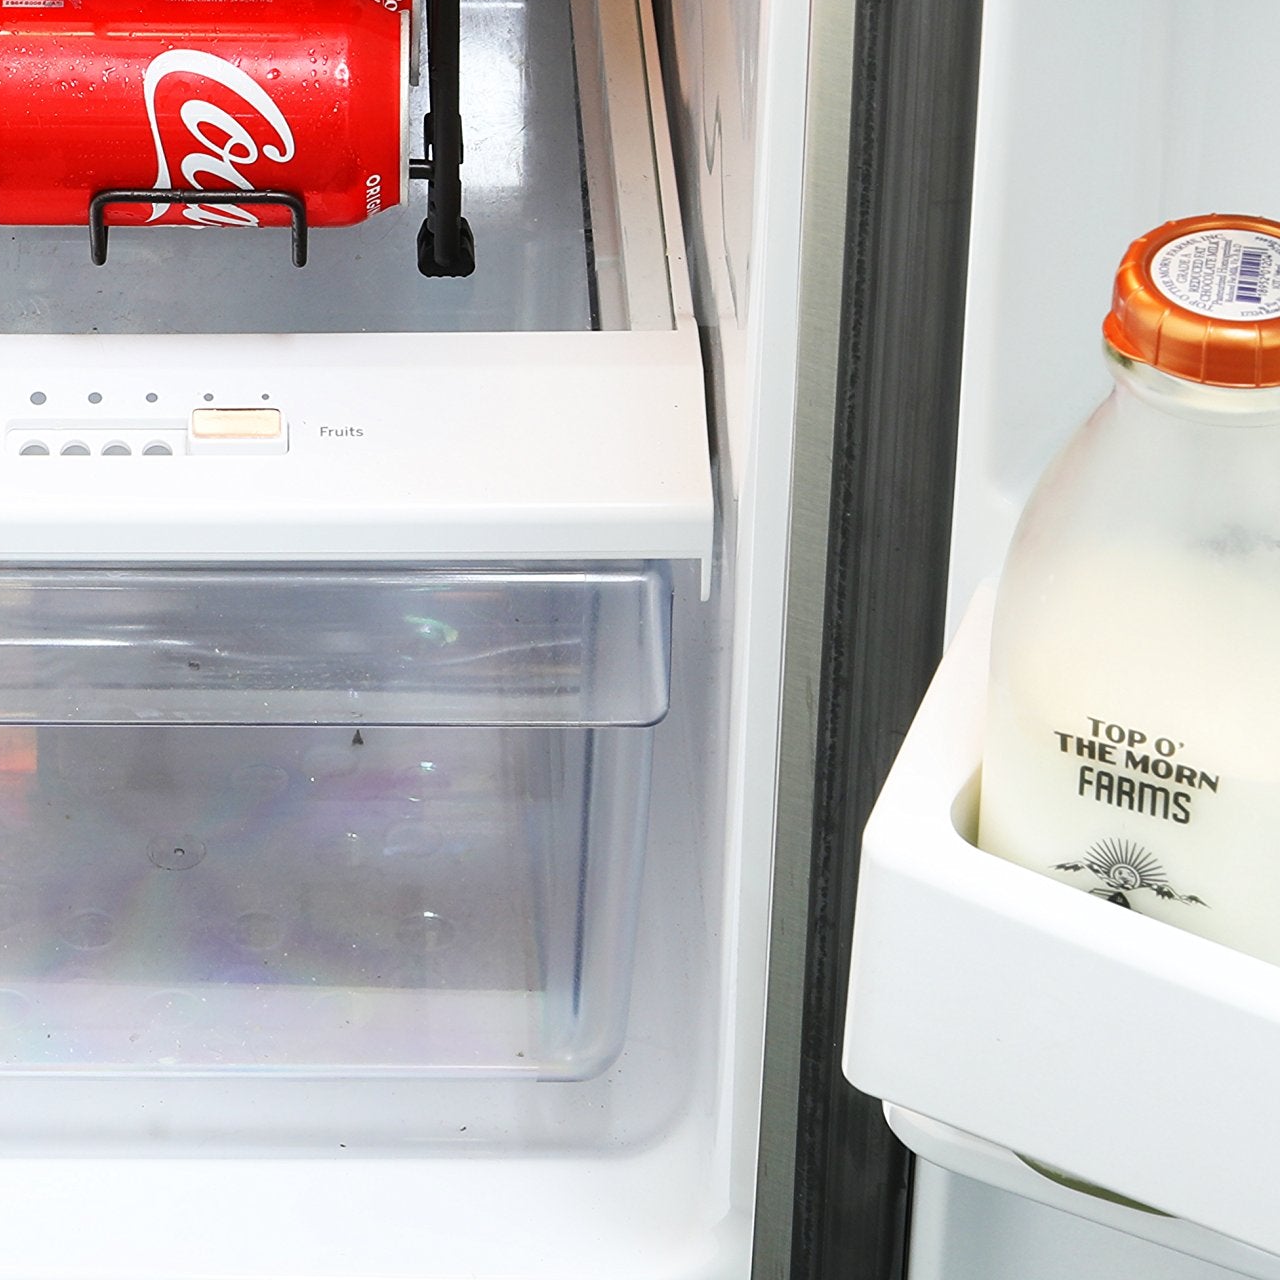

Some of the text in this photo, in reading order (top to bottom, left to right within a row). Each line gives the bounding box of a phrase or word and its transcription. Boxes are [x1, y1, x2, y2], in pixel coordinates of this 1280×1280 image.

[1159, 256, 1171, 279] MORN
[1176, 261, 1191, 284] GRADE
[1189, 246, 1206, 293] REDUCED FAT
[1200, 240, 1220, 303] CHOCOLATE MILK
[319, 425, 365, 438] Fruits
[1087, 716, 1184, 757] TOP O'
[1054, 730, 1220, 794] THE MORN
[1078, 765, 1192, 824] FARMS
